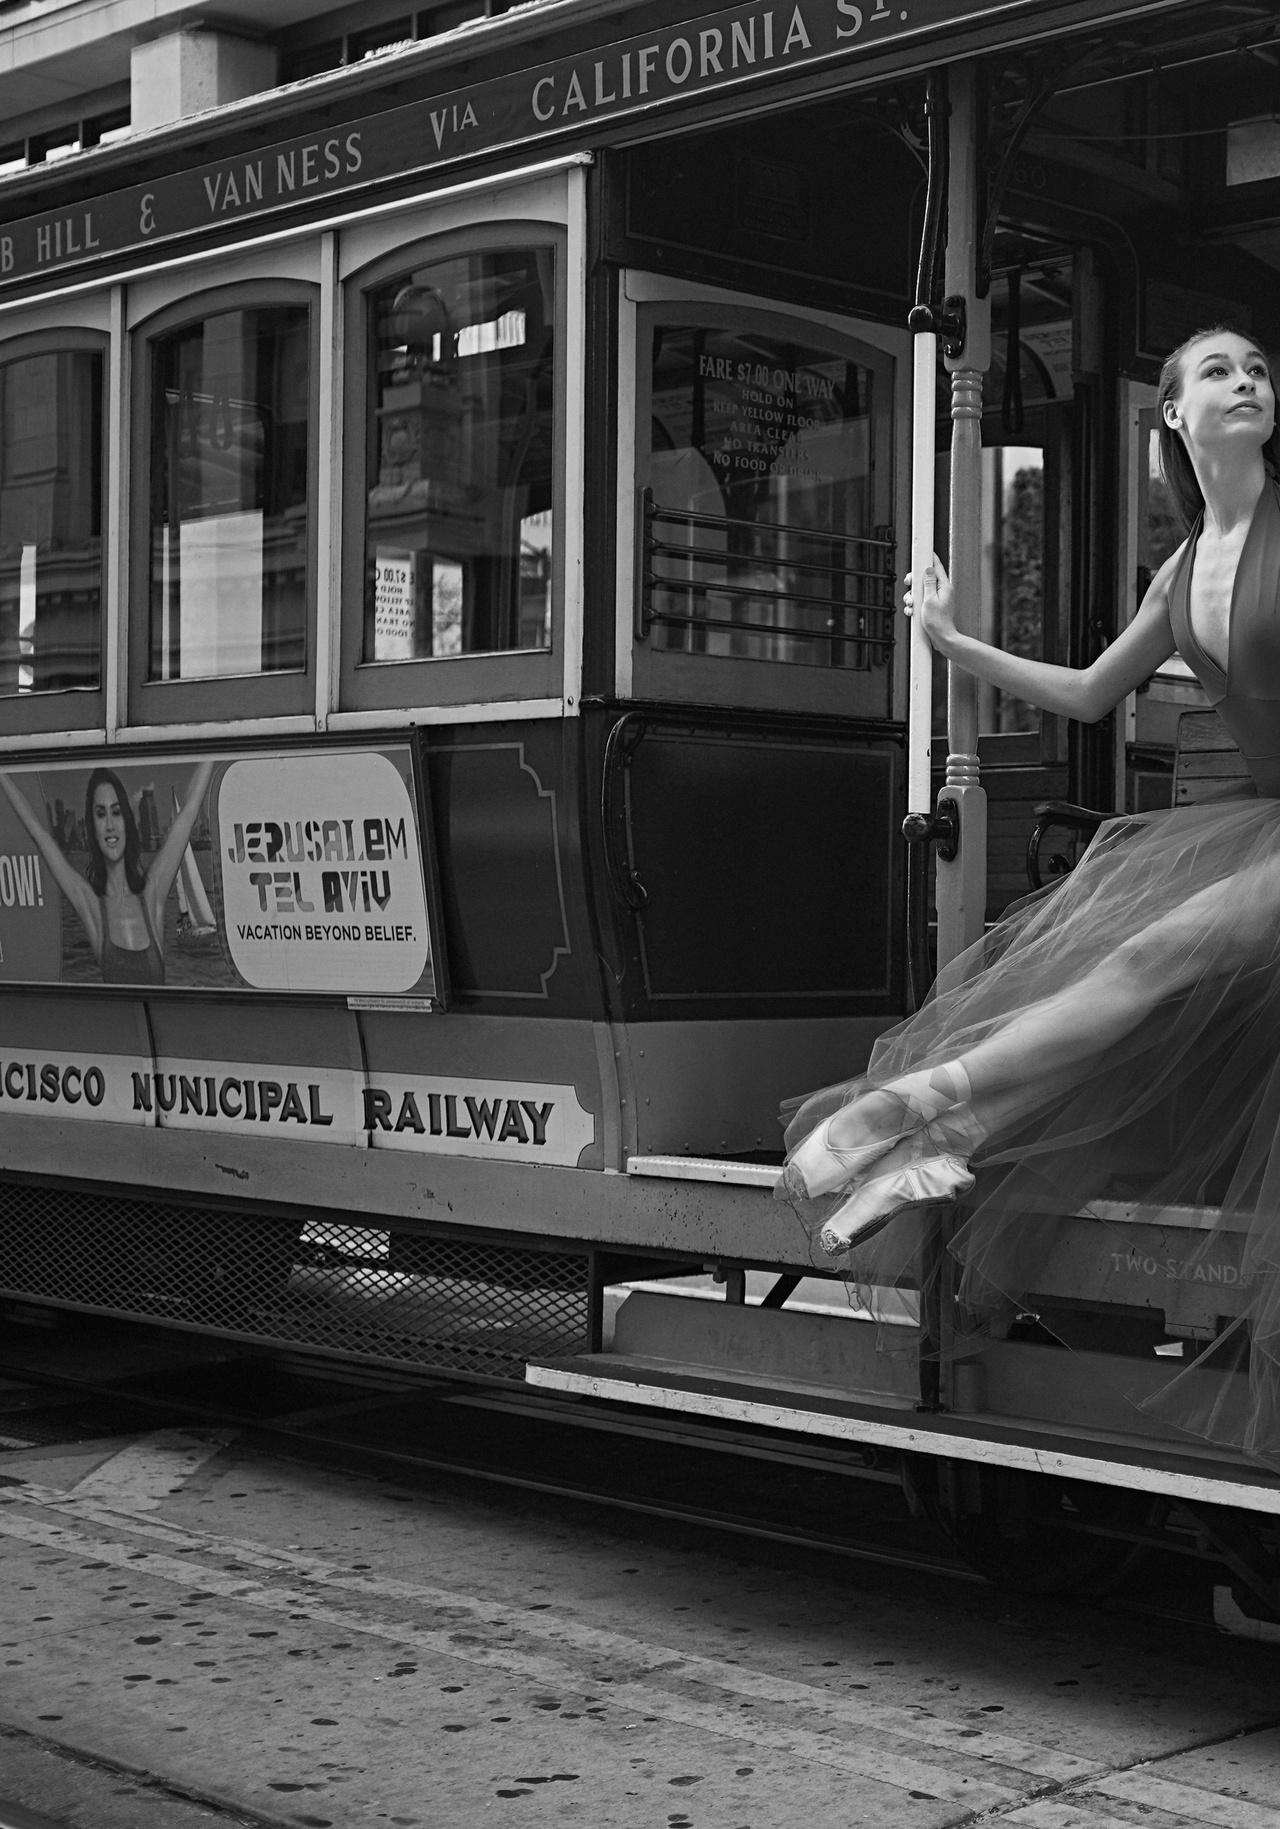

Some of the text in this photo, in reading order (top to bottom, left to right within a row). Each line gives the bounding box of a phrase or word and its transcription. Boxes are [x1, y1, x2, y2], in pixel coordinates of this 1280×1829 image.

[37, 212, 100, 263] HILL
[139, 193, 156, 235] &
[203, 160, 265, 213] VAN
[276, 131, 363, 195] NESS
[429, 101, 479, 151] VIA
[531, 4, 813, 122] CALIFORNIA
[699, 354, 836, 400] FARE $7.00 ONE WAY
[713, 401, 820, 430] KEEP YELLOW FLOOR
[742, 389, 794, 409] HOLD ON
[713, 449, 731, 467] NO
[735, 456, 767, 471] FOOD
[723, 436, 742, 451] NO
[228, 818, 408, 863] JERUSALEM
[0, 855, 44, 906] OW!
[249, 871, 315, 913] TEL
[237, 924, 417, 942] VACATION BEYOND BELIEF.
[0, 1062, 106, 1107] CISCO
[362, 1088, 555, 1145] RAILWAY
[1111, 1253, 1158, 1275] TWO
